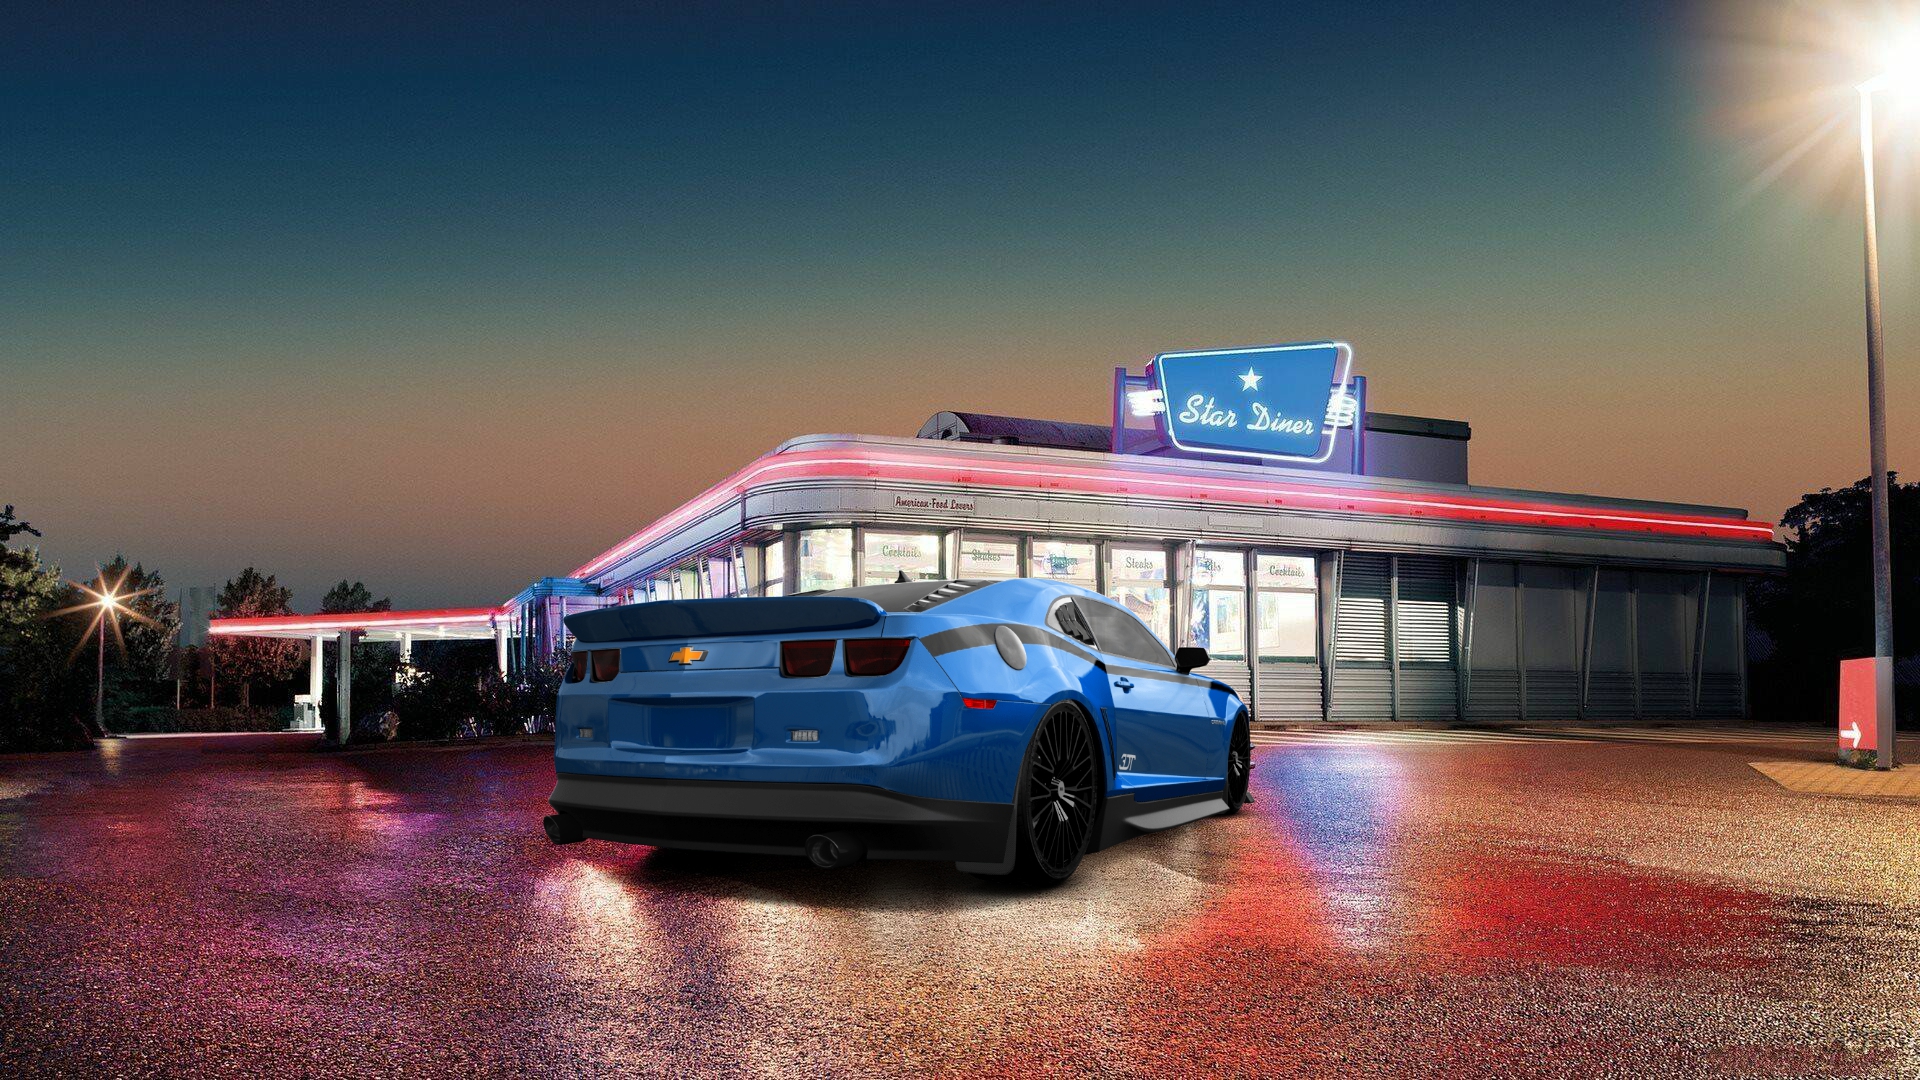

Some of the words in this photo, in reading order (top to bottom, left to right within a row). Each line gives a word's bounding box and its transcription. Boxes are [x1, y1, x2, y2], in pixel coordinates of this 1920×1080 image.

[1179, 394, 1237, 428] Star
[1246, 402, 1314, 435] Diner
[895, 496, 948, 509] American-Food
[950, 499, 973, 510] Lovers
[882, 544, 922, 558] Cocktails
[1125, 556, 1153, 569] Steaks
[1269, 564, 1305, 577] Cocktails
